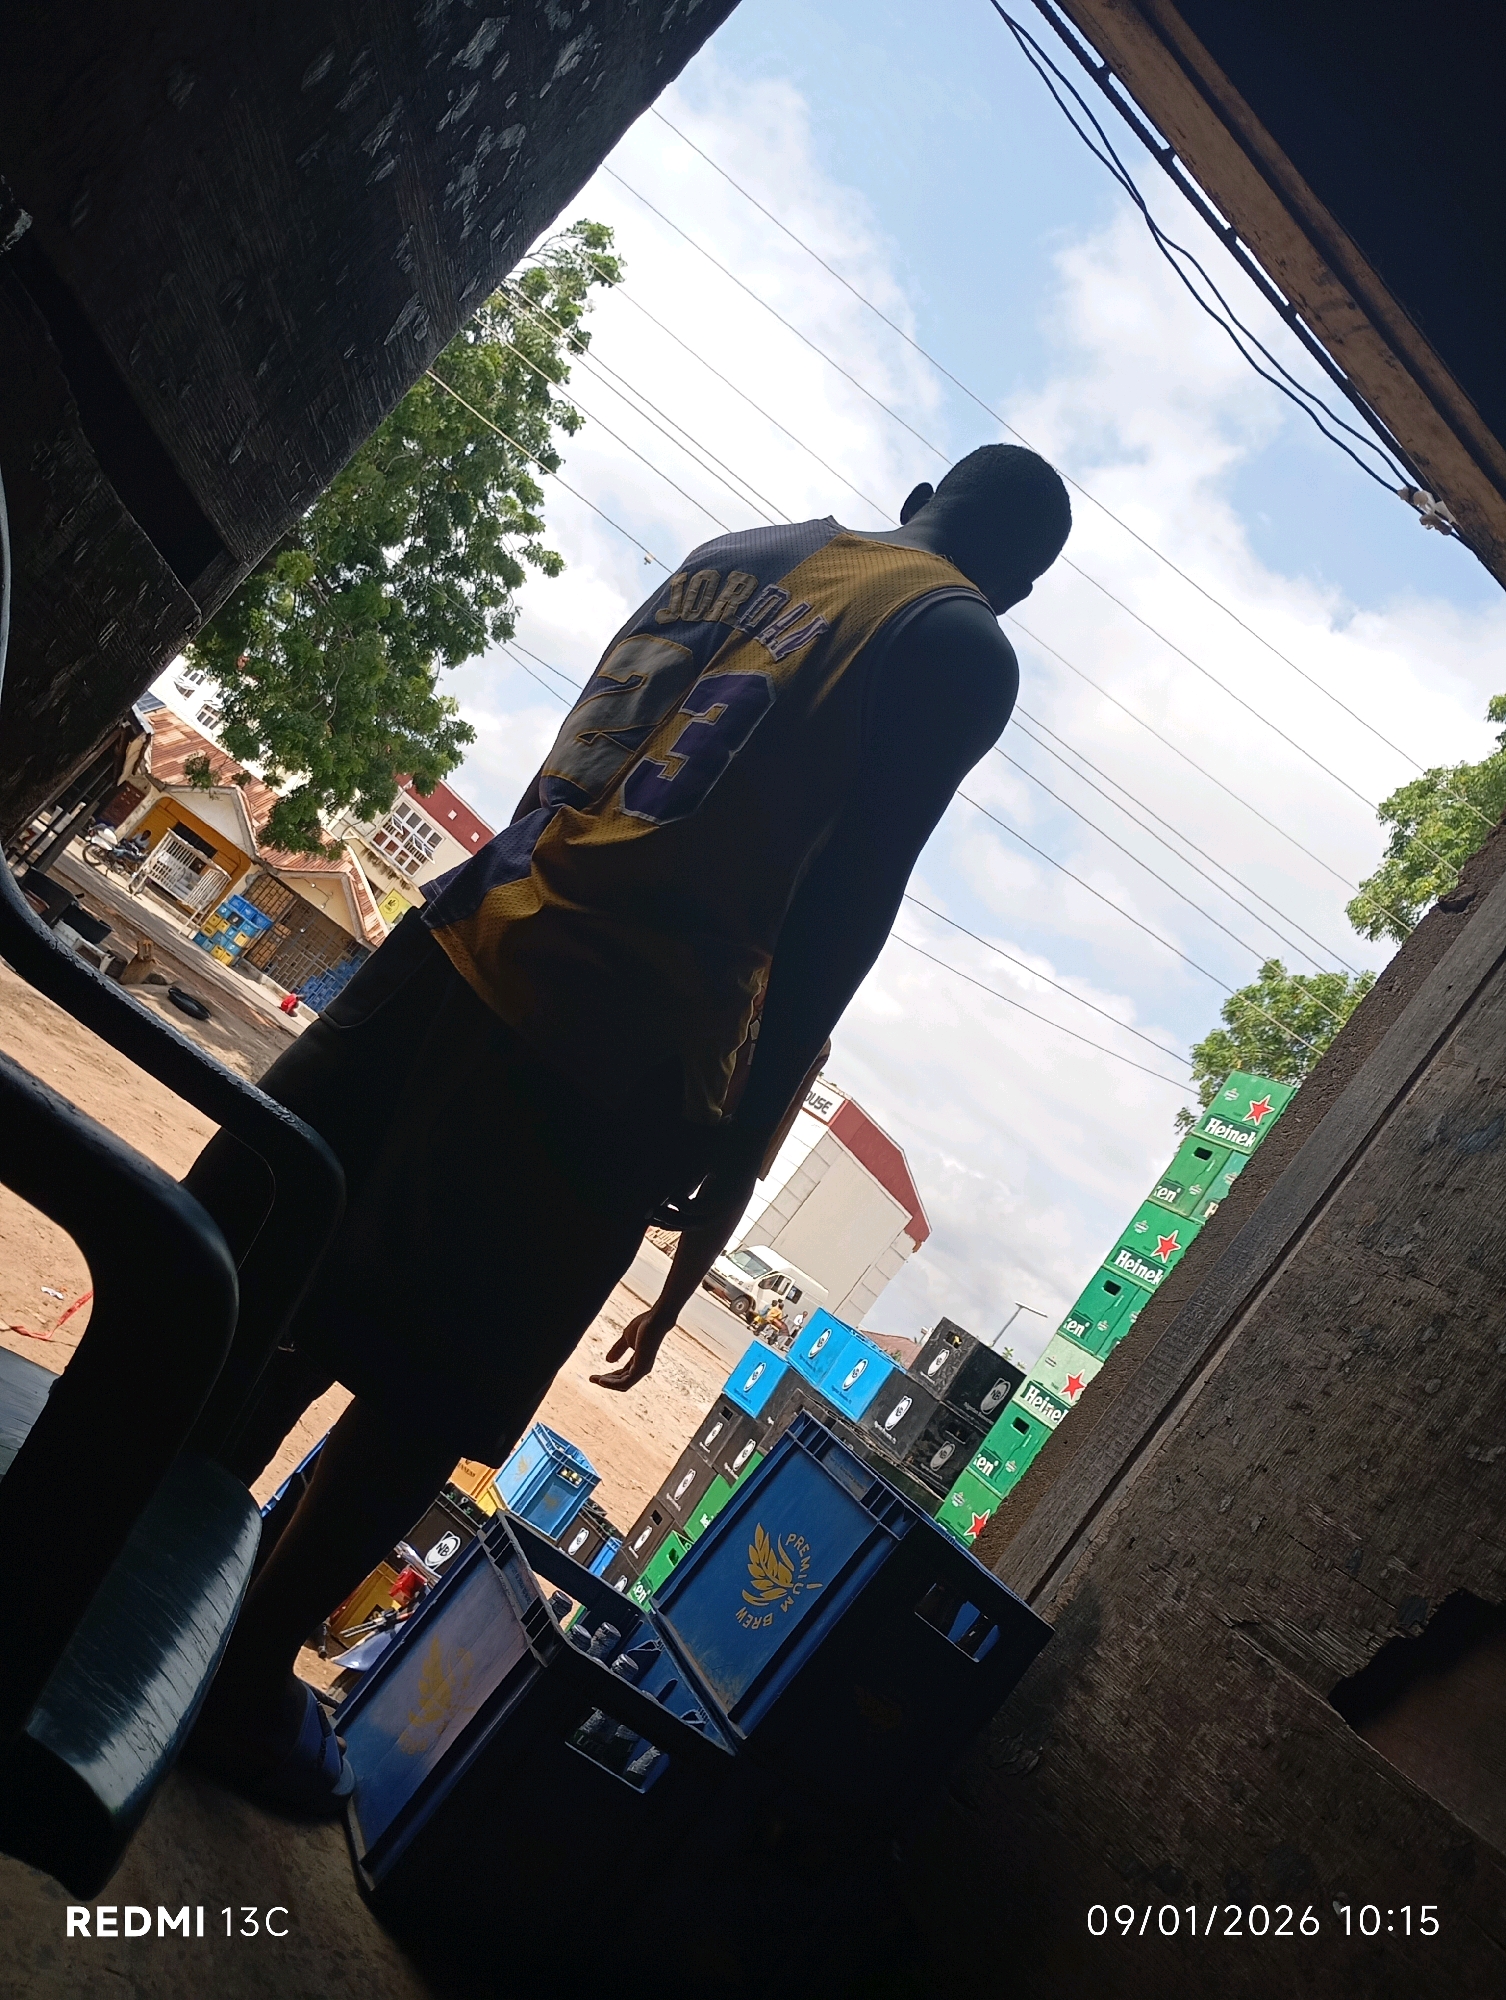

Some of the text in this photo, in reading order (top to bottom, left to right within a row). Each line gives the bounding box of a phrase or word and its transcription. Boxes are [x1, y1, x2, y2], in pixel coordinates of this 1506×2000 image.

[655, 569, 830, 662] JORDAN
[436, 1542, 450, 1557] NB
[780, 1533, 812, 1613] PREMIUM
[735, 1606, 774, 1630] BREW
